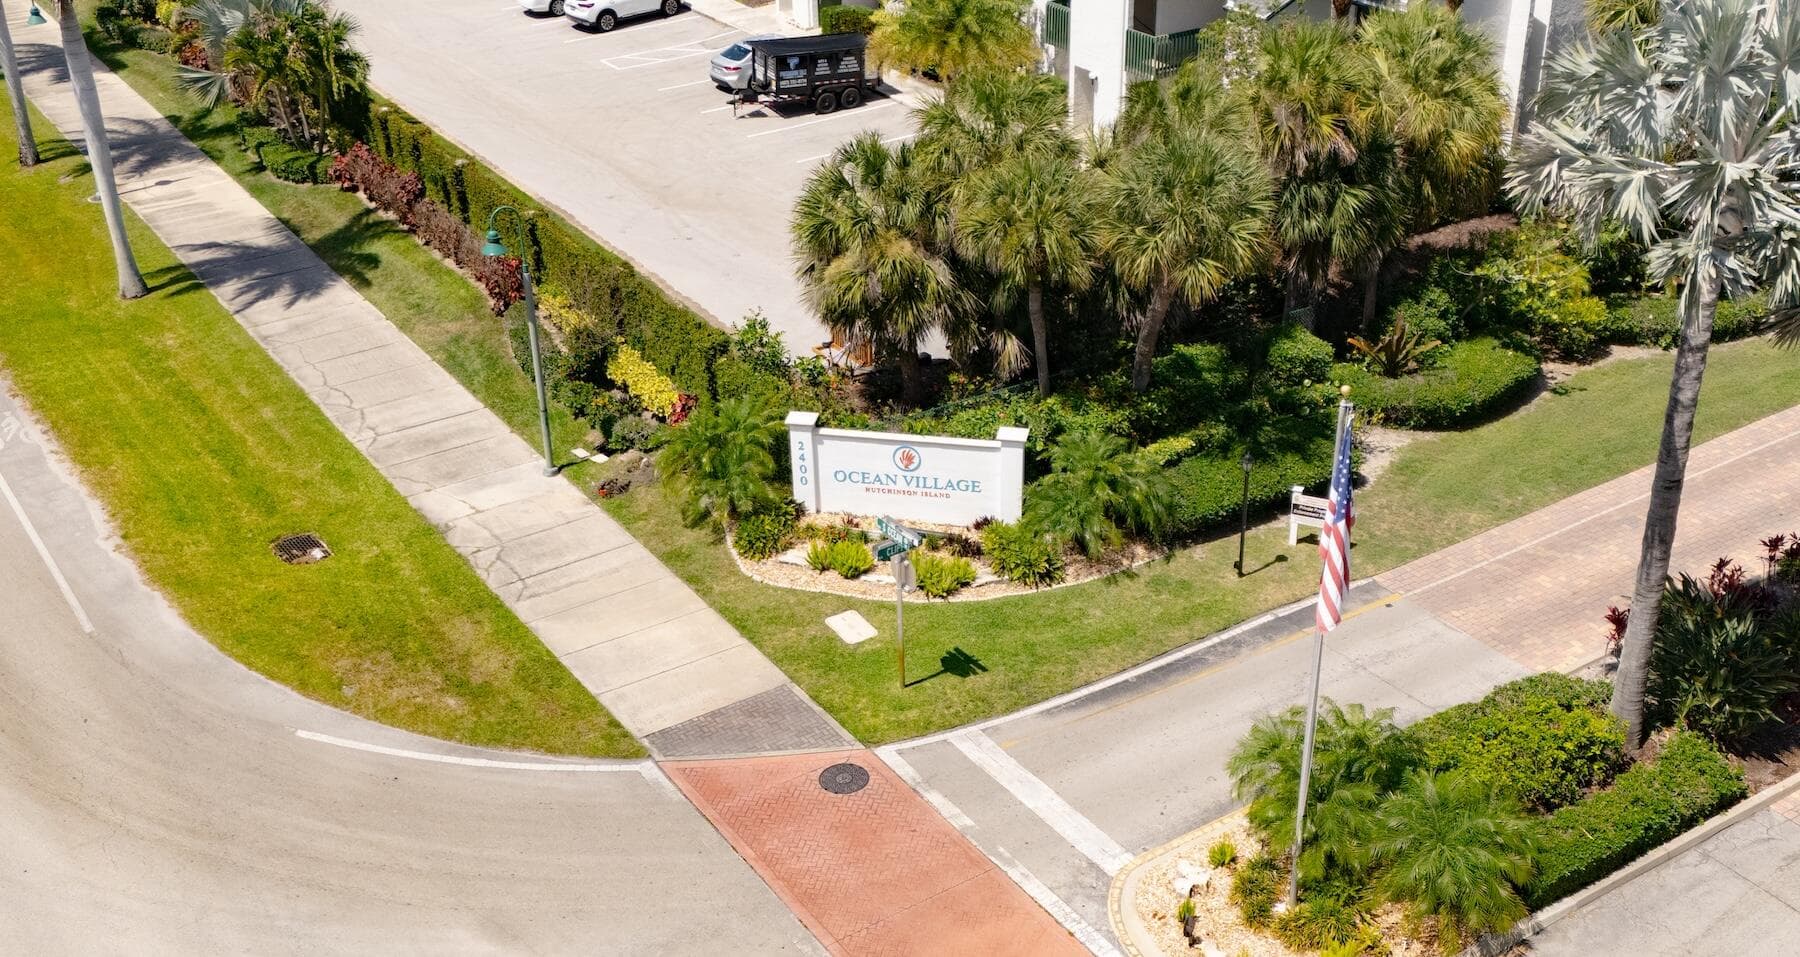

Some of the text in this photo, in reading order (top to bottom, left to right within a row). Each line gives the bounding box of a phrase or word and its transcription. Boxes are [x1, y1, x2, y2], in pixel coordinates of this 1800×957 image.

[797, 440, 808, 486] 2400
[834, 470, 982, 493] OCEAN VILLAGE
[865, 487, 918, 497] HUTCHINSON
